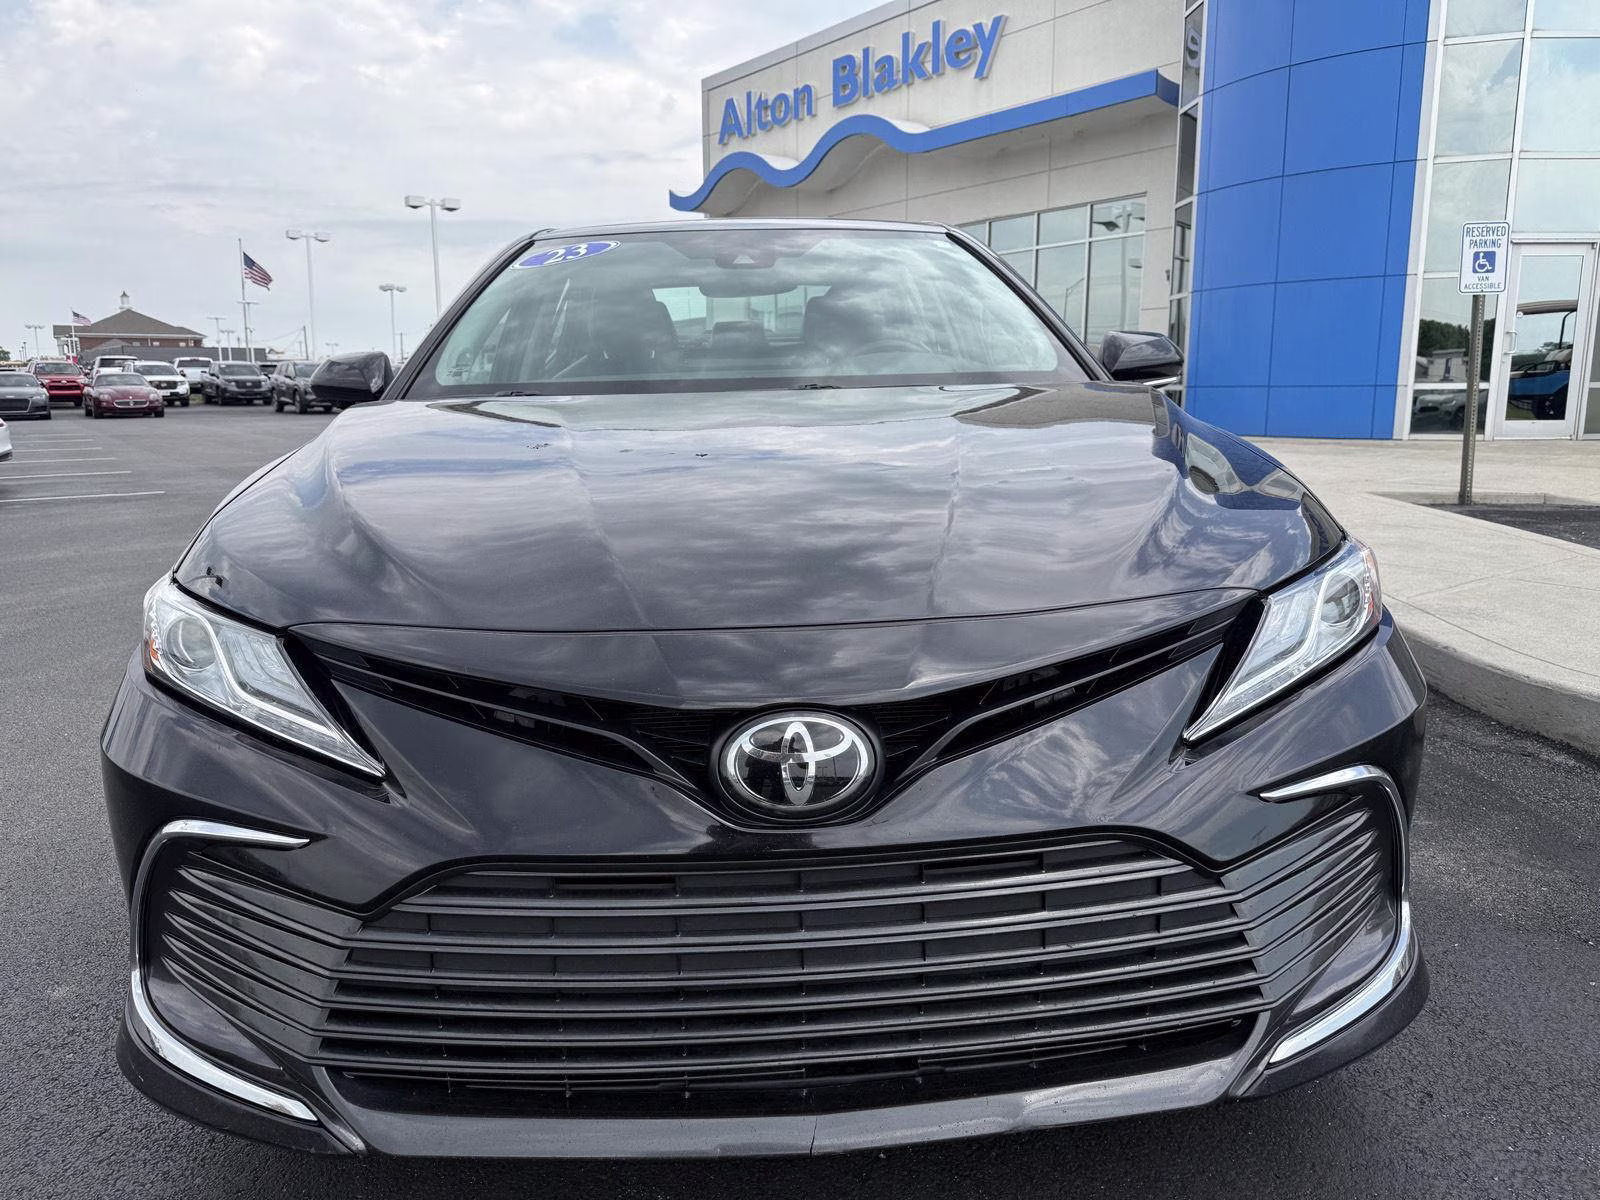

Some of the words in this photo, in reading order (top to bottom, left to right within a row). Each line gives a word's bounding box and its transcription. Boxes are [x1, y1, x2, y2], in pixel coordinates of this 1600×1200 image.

[718, 82, 817, 145] Alton
[832, 13, 1008, 108] Blakley
[1466, 226, 1506, 237] RESERVED
[1470, 238, 1502, 249] PARKING
[543, 243, 588, 264] 23
[1464, 282, 1502, 290] ACCESSIBLE
